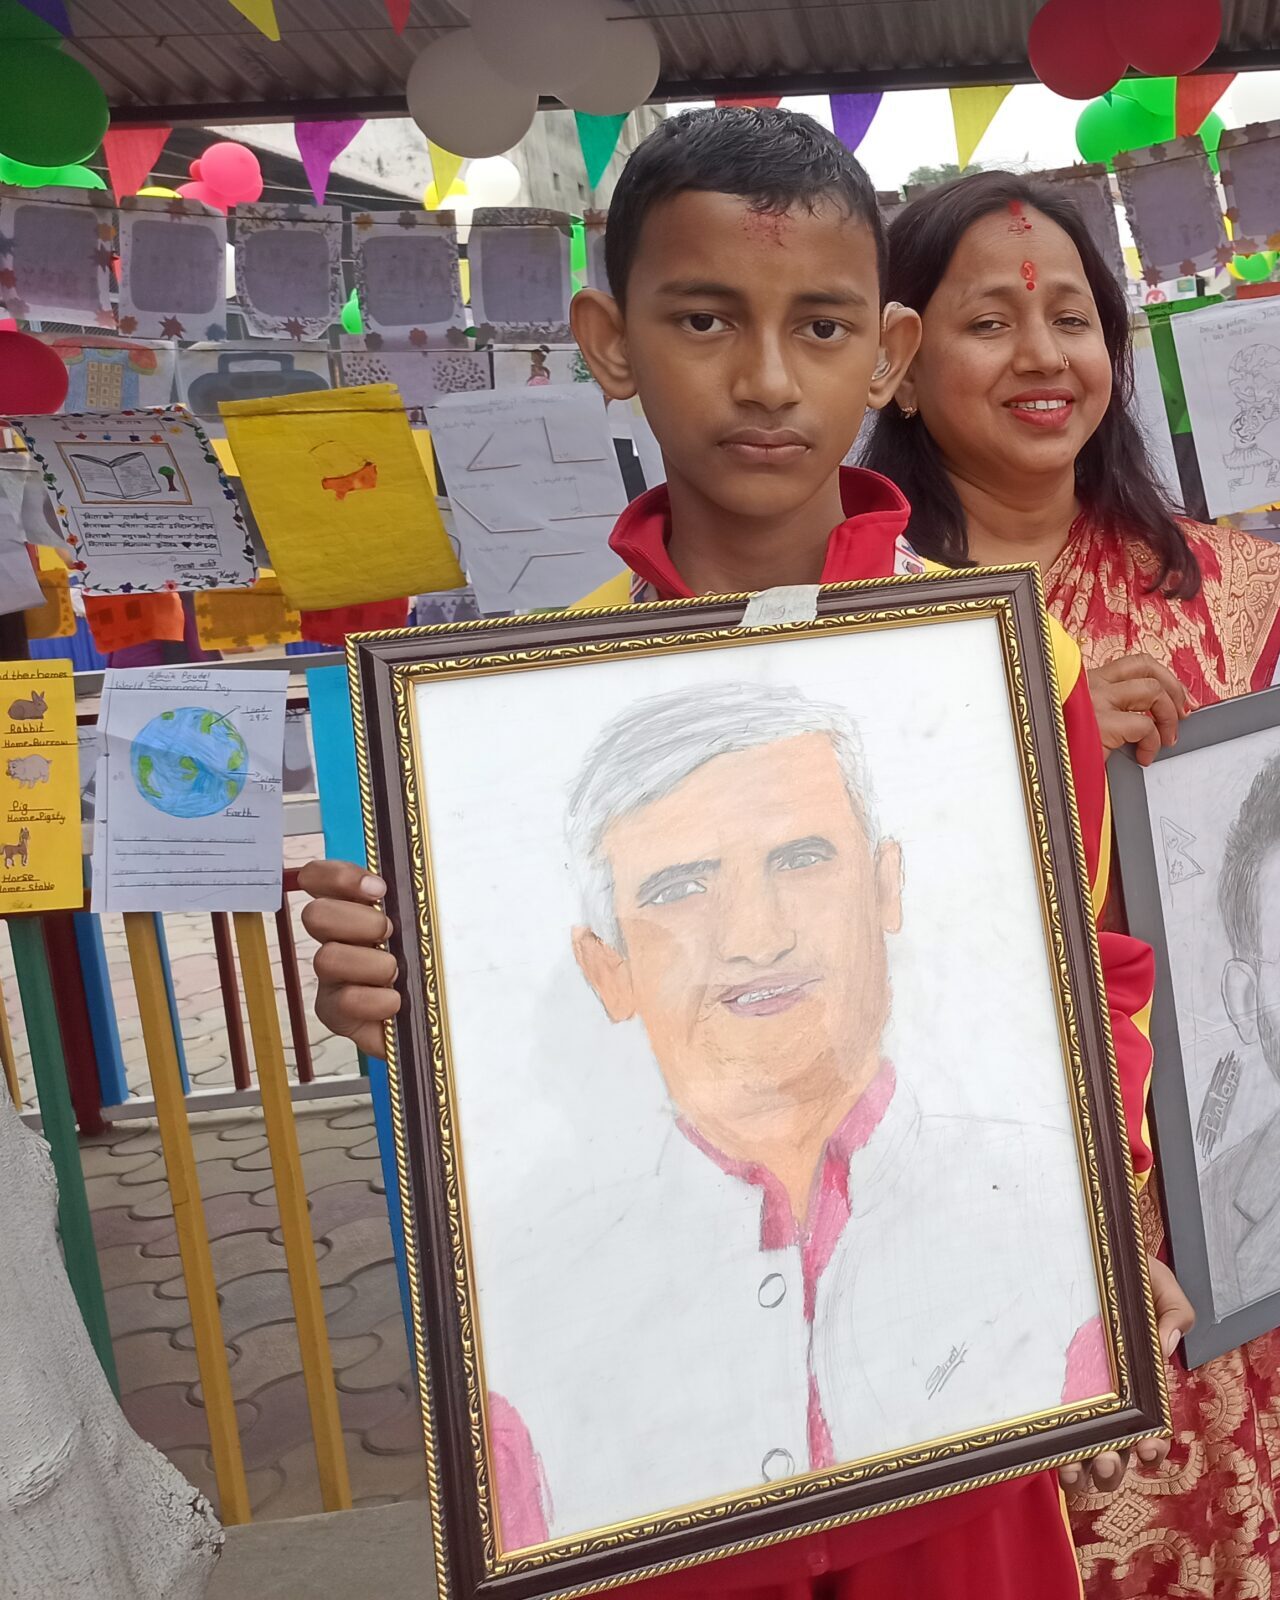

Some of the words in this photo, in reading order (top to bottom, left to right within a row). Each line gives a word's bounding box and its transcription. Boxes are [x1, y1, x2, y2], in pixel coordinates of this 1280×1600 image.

[10, 722, 44, 734] Rabbit
[12, 800, 29, 815] Pig
[3, 873, 35, 883] Horse
